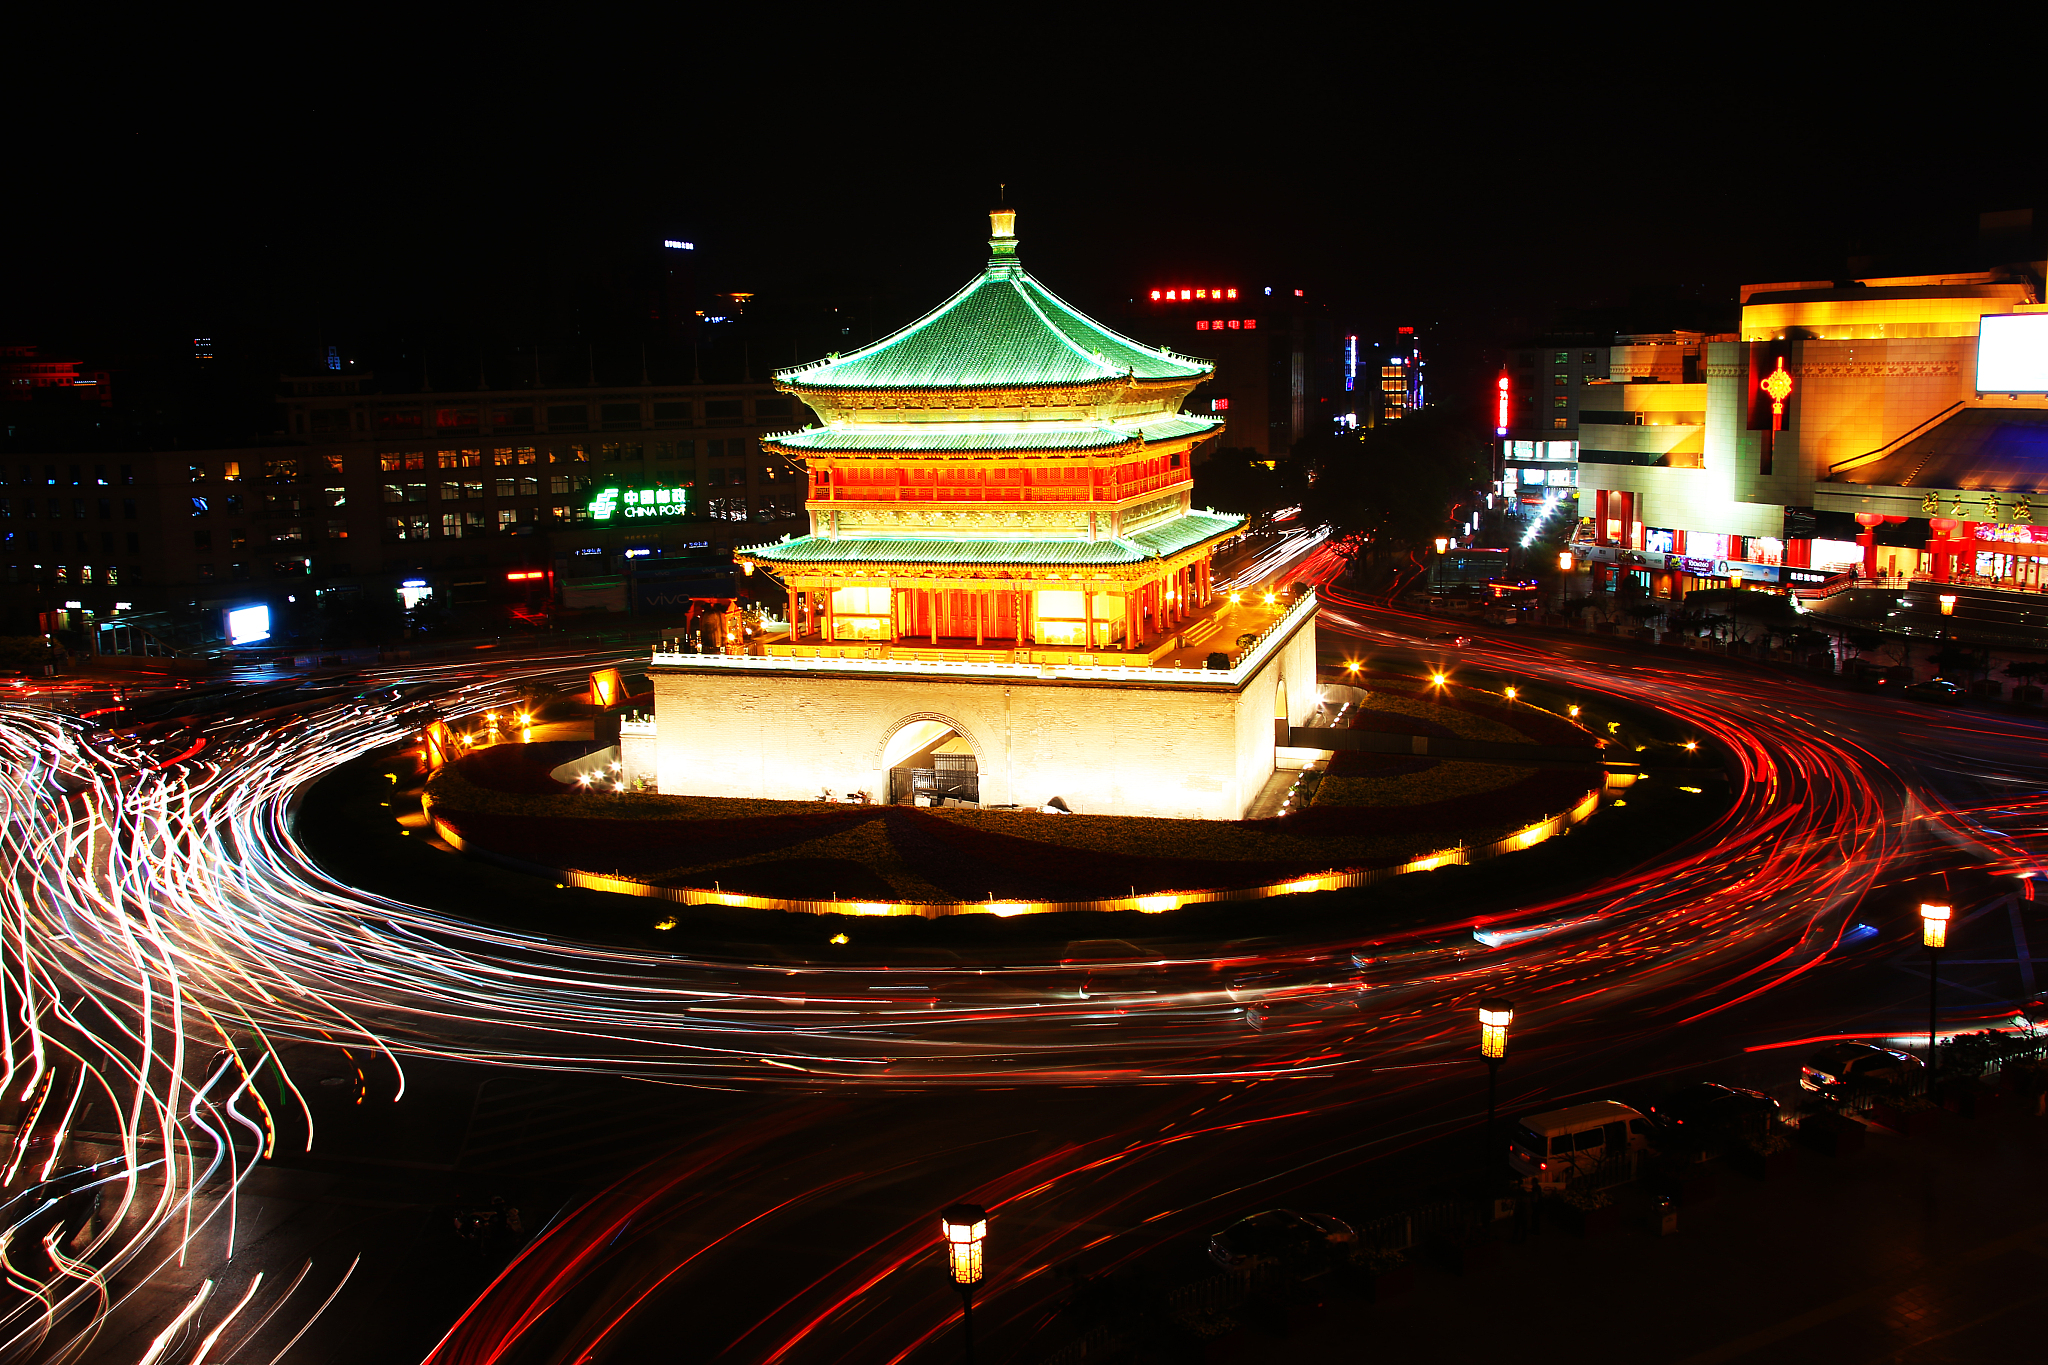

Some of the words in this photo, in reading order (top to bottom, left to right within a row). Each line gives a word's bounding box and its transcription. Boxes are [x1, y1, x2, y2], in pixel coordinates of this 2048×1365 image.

[1196, 319, 1257, 331] 国美电器
[624, 487, 686, 505] 中国邮政
[624, 506, 657, 518] CHINA
[659, 504, 686, 516] POST
[646, 592, 690, 606] vivo
